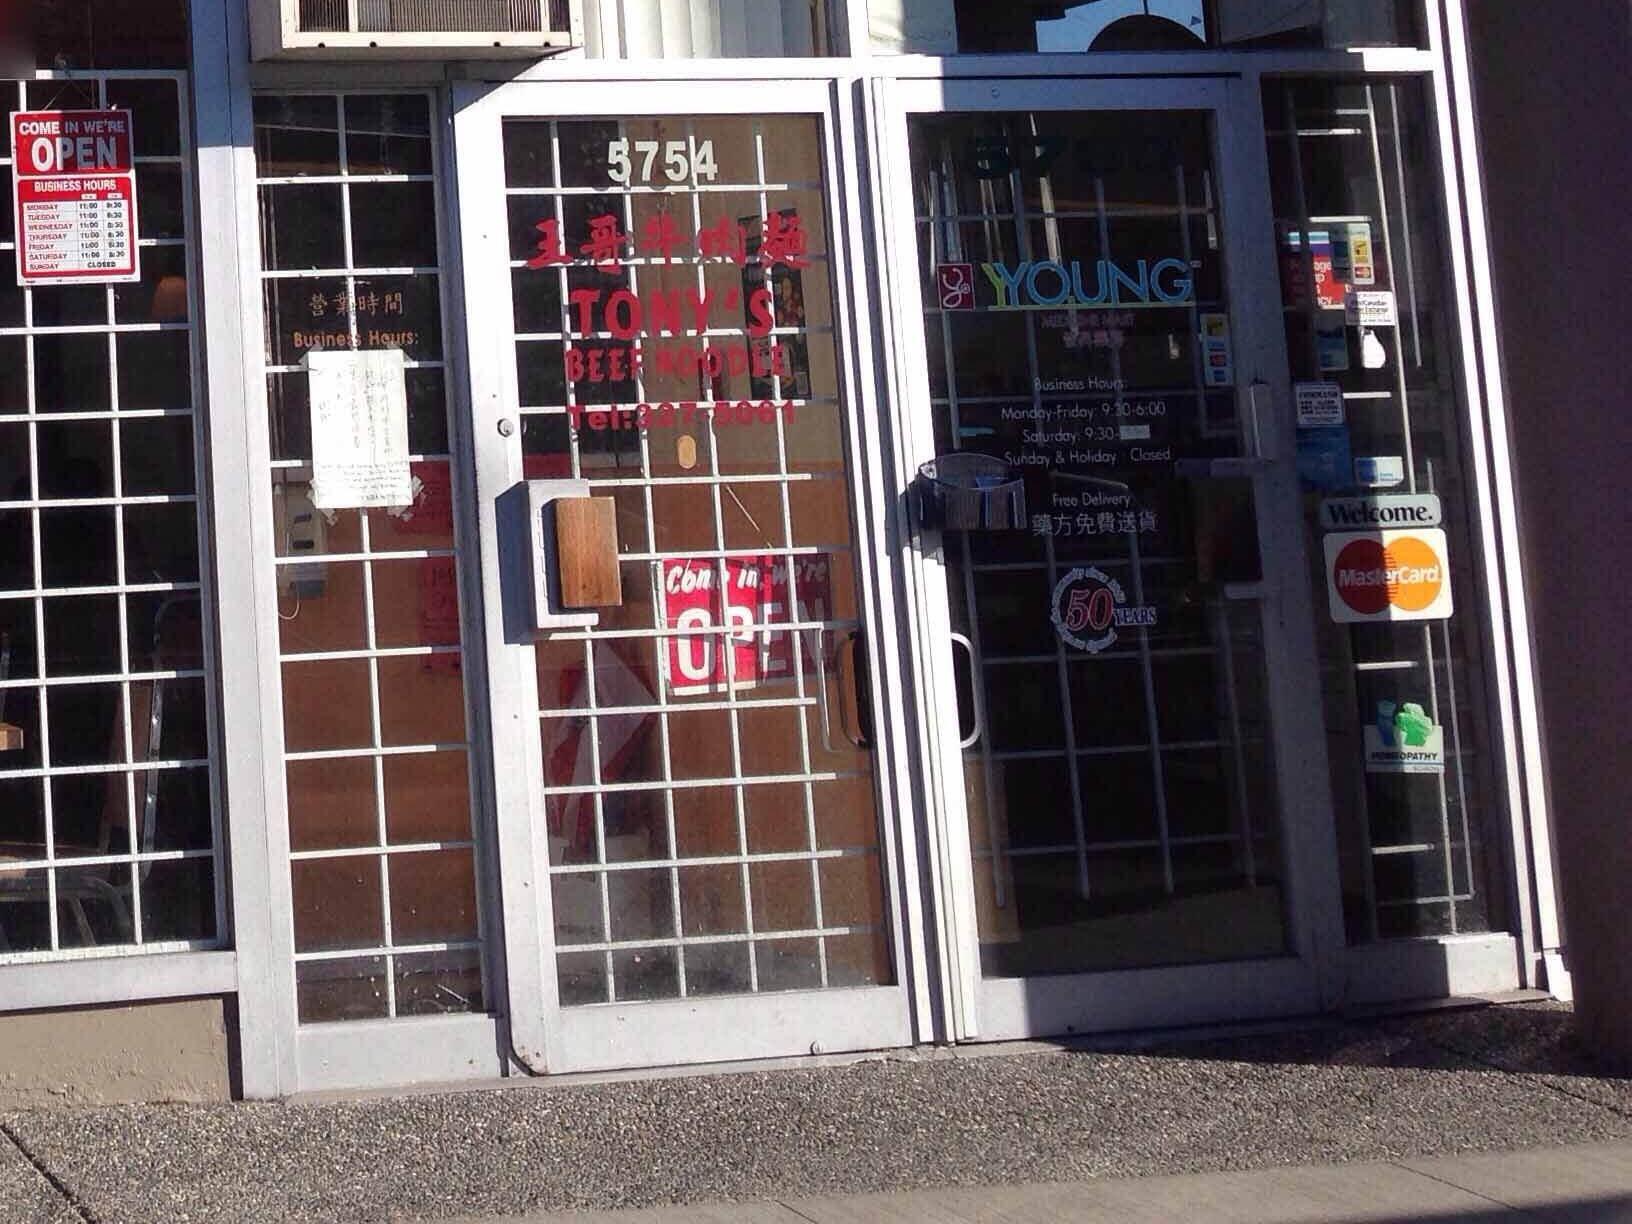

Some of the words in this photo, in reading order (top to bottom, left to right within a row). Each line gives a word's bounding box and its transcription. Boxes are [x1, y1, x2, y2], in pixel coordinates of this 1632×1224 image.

[19, 121, 60, 135] COME
[65, 121, 78, 133] IN
[83, 119, 126, 134] WE'RE
[31, 136, 117, 172] OPEN
[607, 139, 718, 182] 5754
[34, 181, 81, 192] BUSINESS
[83, 180, 116, 191] HOURS
[569, 287, 775, 340] TONY'S
[294, 330, 363, 349] Business
[369, 329, 418, 346] Hours:
[564, 345, 644, 382] BEEF
[656, 344, 786, 378] NOODLE
[1034, 377, 1084, 392] Business
[1005, 451, 1050, 466] Sunday
[1055, 450, 1066, 464] &
[1130, 446, 1171, 462] Closed
[1052, 493, 1078, 507] Free
[1082, 491, 1130, 508] Delivery
[1338, 564, 1440, 588] MasterCard
[1066, 588, 1114, 632] 50
[676, 597, 826, 681] OPEN
